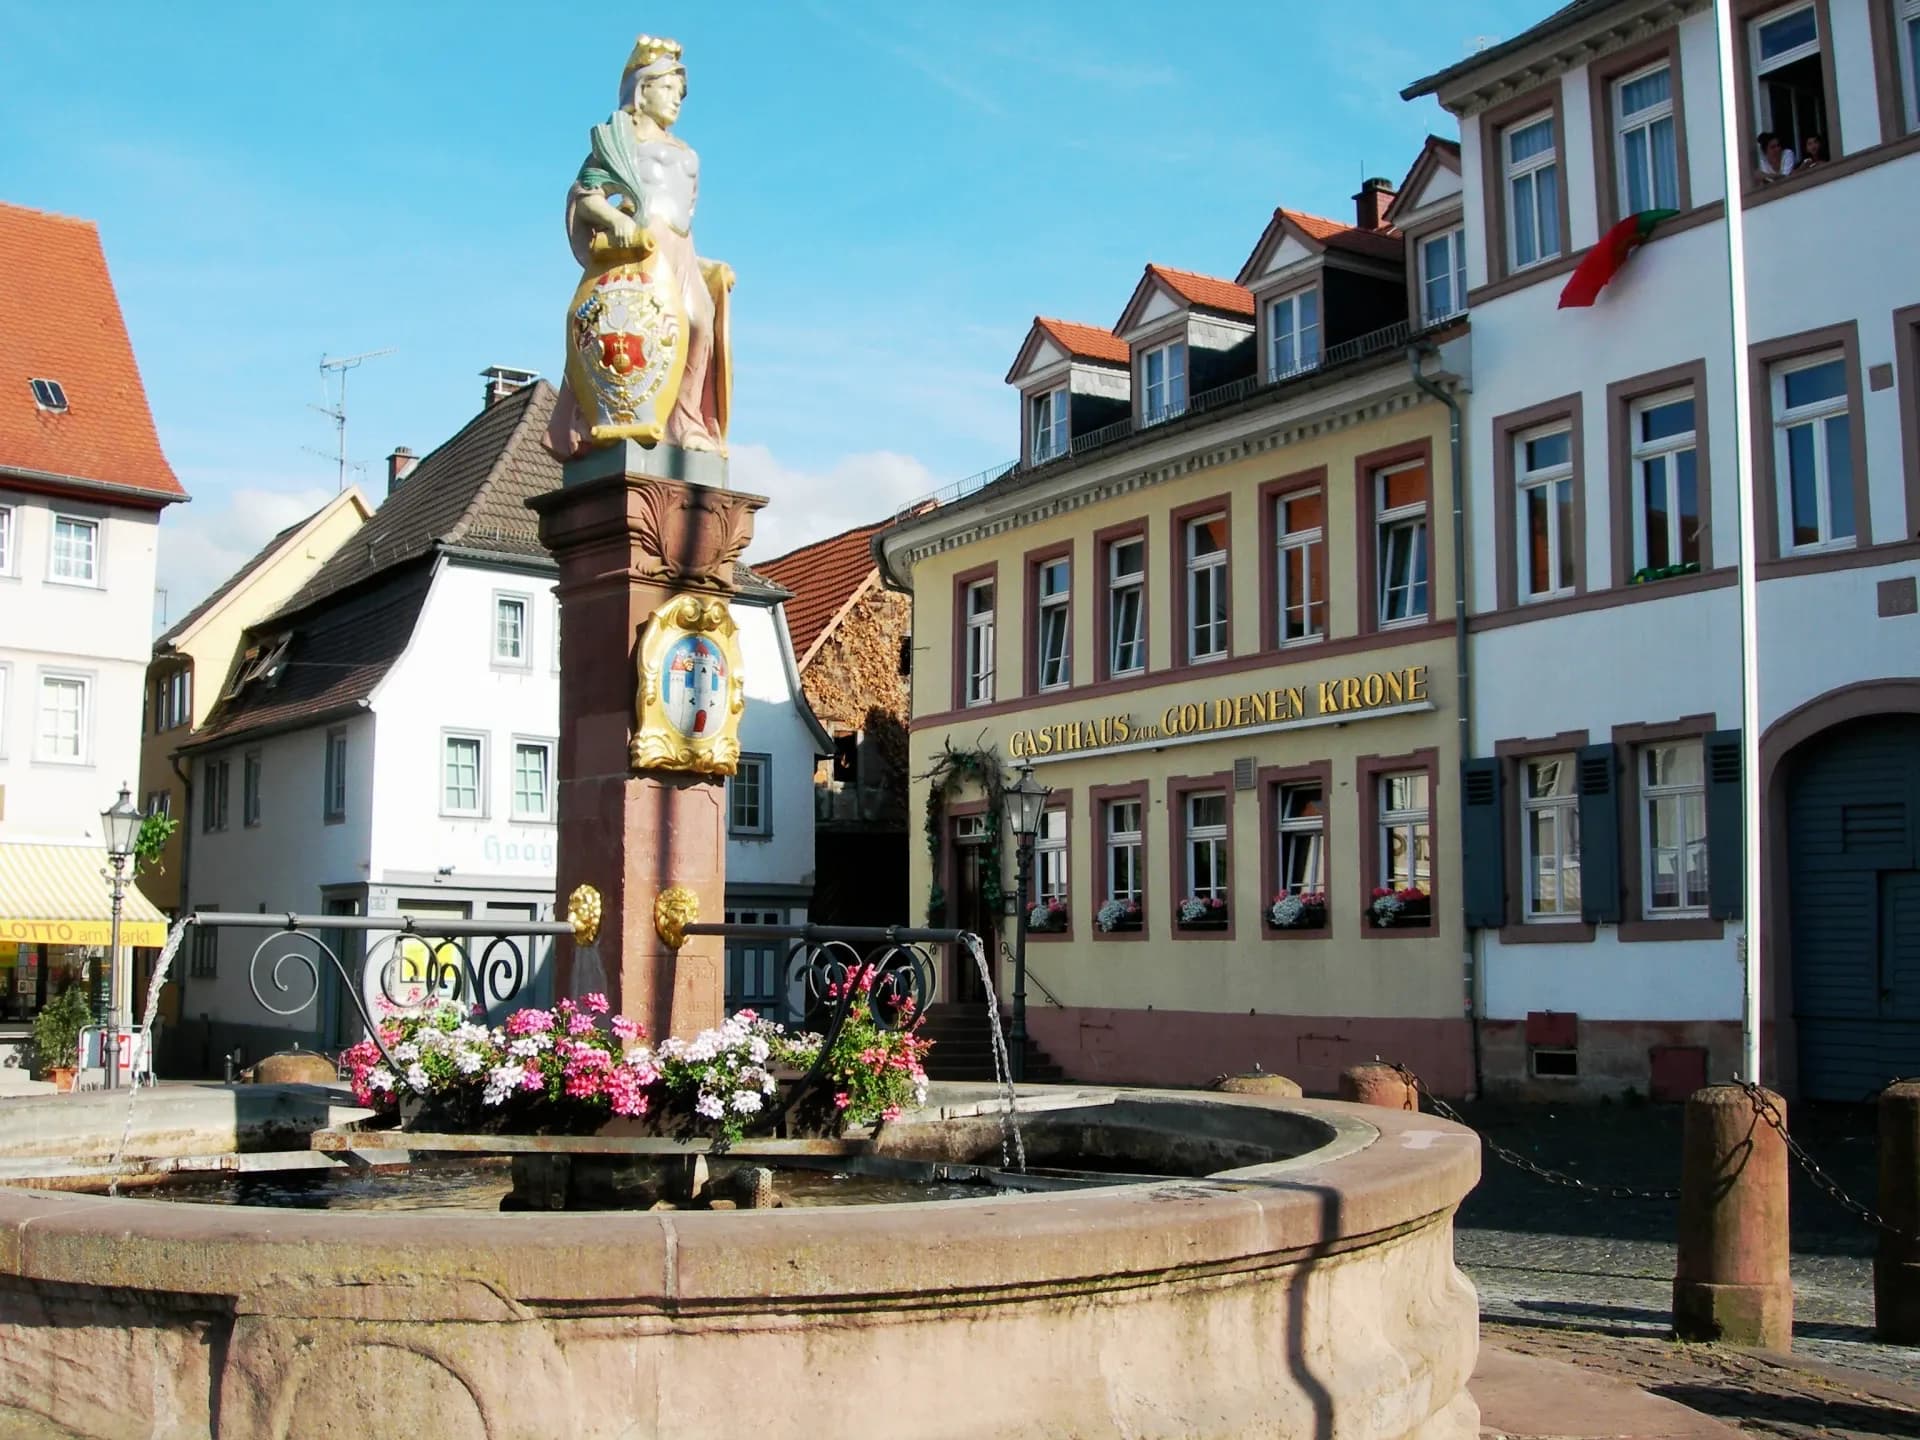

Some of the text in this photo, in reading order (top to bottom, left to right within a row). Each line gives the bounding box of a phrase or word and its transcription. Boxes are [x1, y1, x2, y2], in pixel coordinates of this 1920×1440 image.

[1009, 664, 1428, 758] GASTHAUS ZUR GOLDENEN KRONE
[0, 922, 73, 941] LOTTO
[80, 930, 103, 943] am
